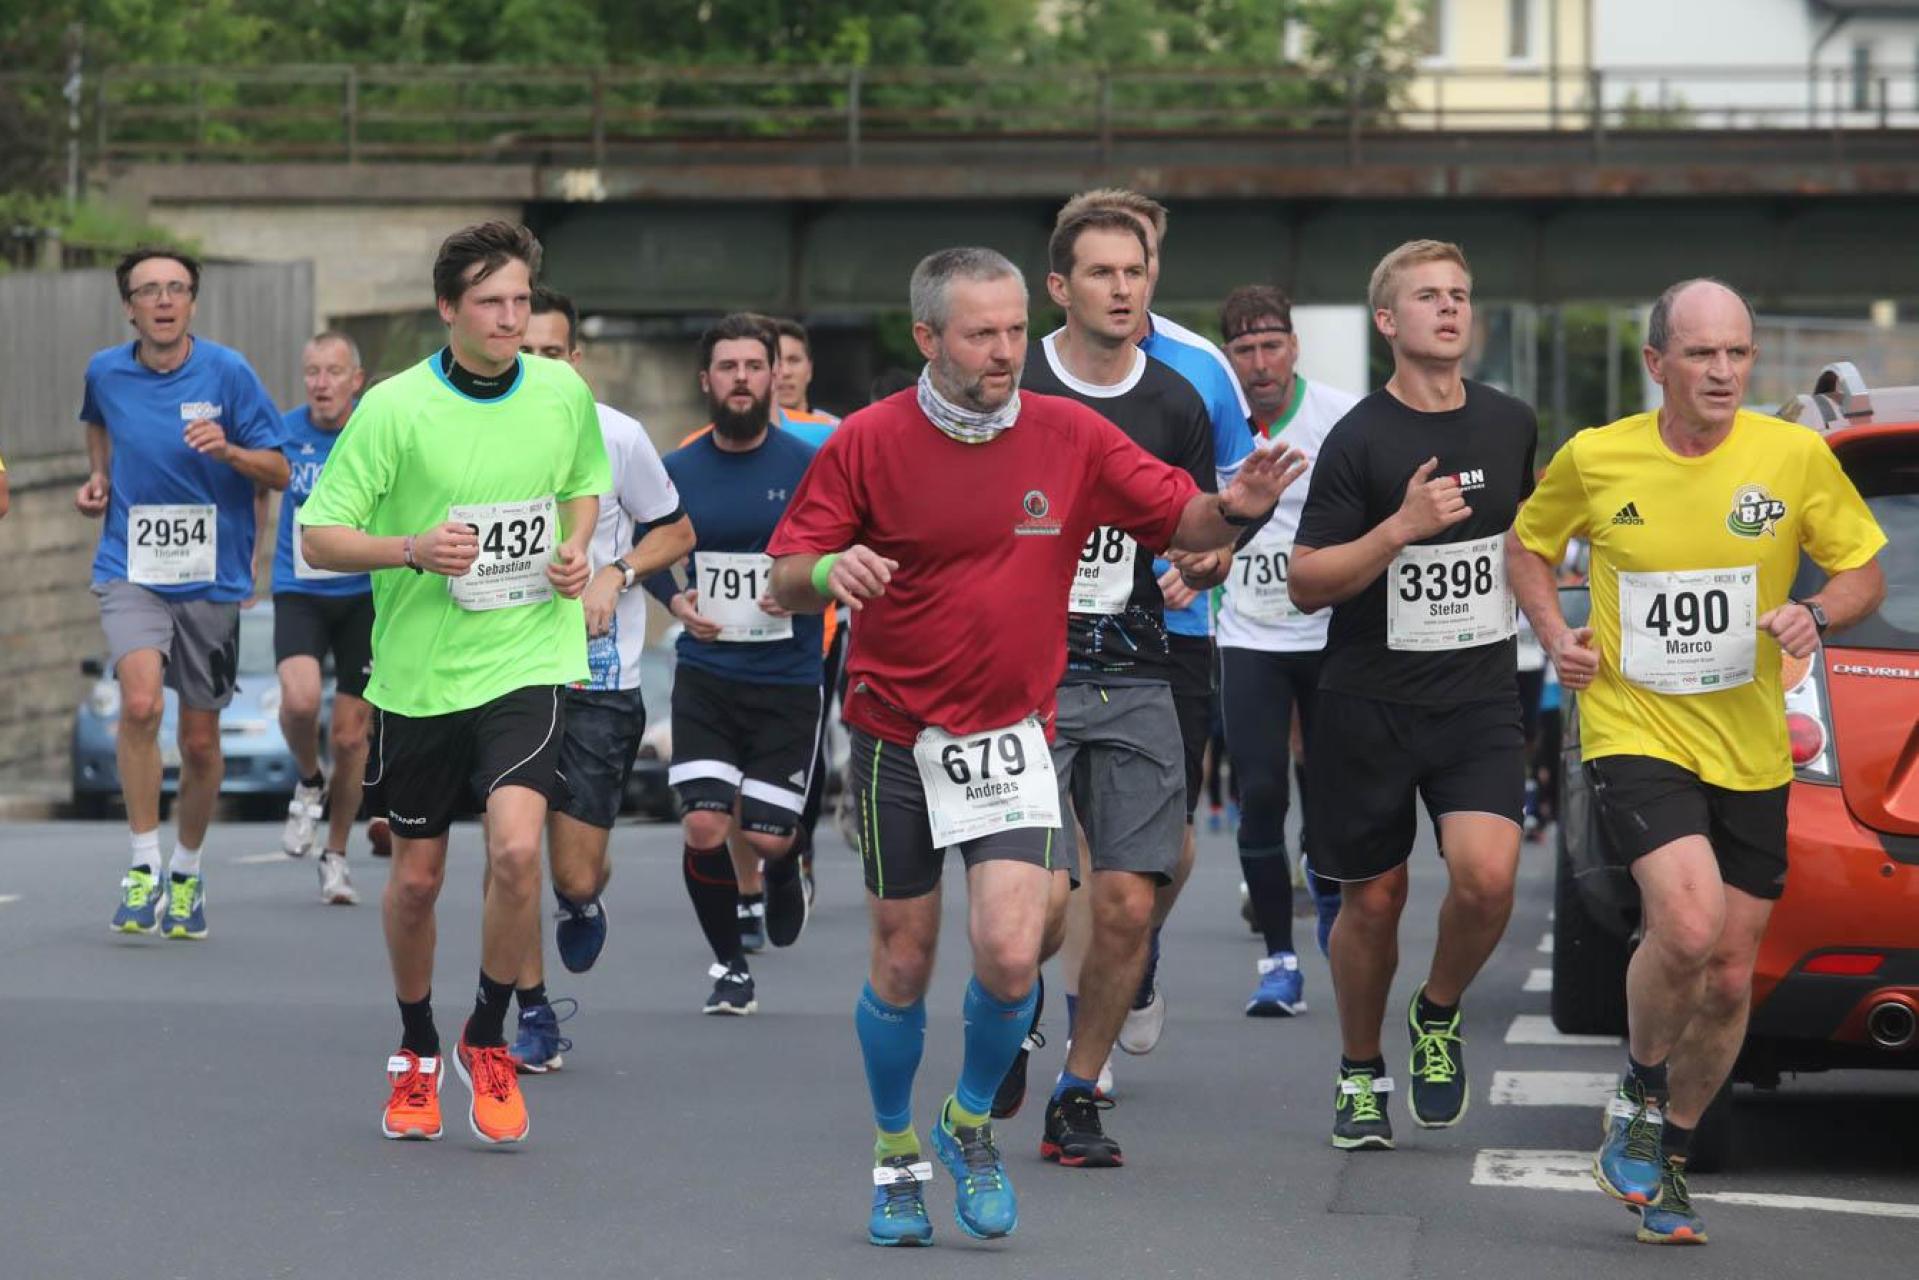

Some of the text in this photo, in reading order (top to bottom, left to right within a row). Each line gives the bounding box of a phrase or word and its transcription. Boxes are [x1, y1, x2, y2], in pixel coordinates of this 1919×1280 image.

[137, 517, 207, 547] 2954
[1612, 517, 1644, 526] adidas
[477, 560, 532, 577] Sebastian
[1399, 555, 1493, 602] 3398
[705, 567, 770, 600] 791
[1429, 602, 1470, 616] Stefan
[1645, 588, 1730, 637] 490
[1665, 639, 1713, 655] Marco
[941, 733, 1026, 785] 679
[965, 781, 1019, 801] Andreas
